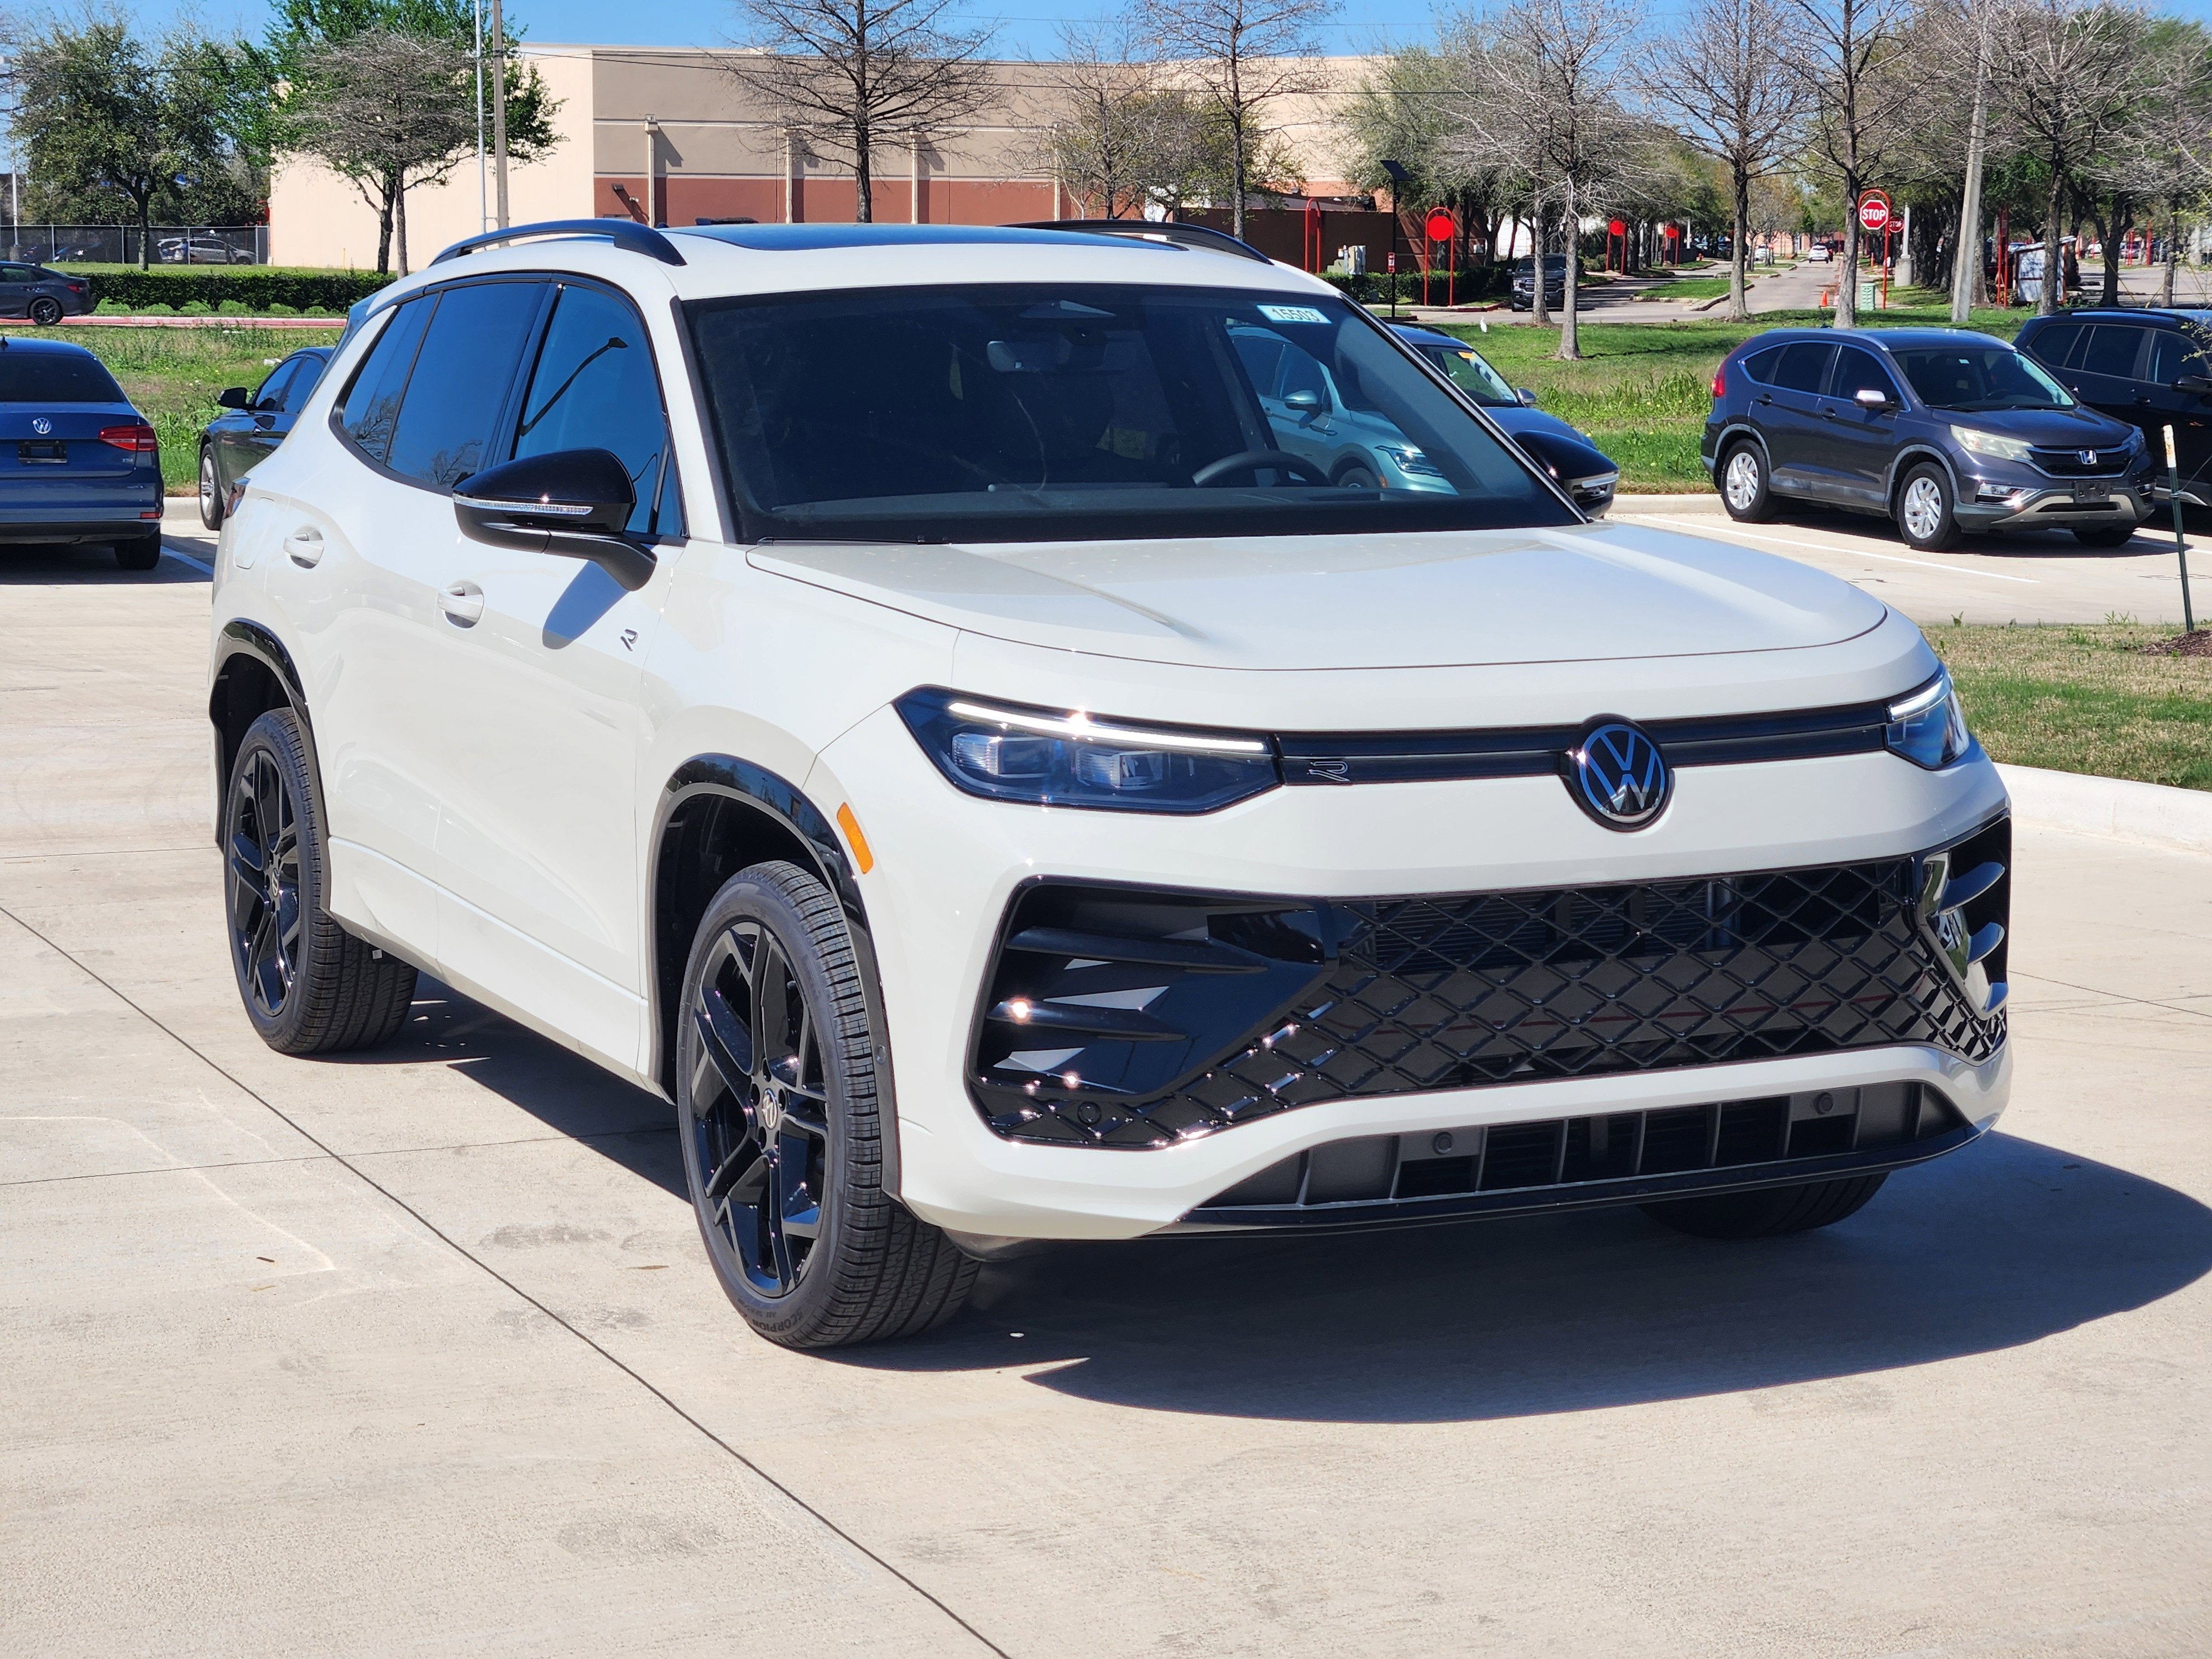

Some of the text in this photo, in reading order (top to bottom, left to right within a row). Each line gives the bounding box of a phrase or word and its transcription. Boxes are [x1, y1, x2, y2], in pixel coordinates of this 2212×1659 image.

[1862, 208, 1886, 221] STOP
[1272, 307, 1320, 322] 15503
[1580, 723, 1665, 823] VW
